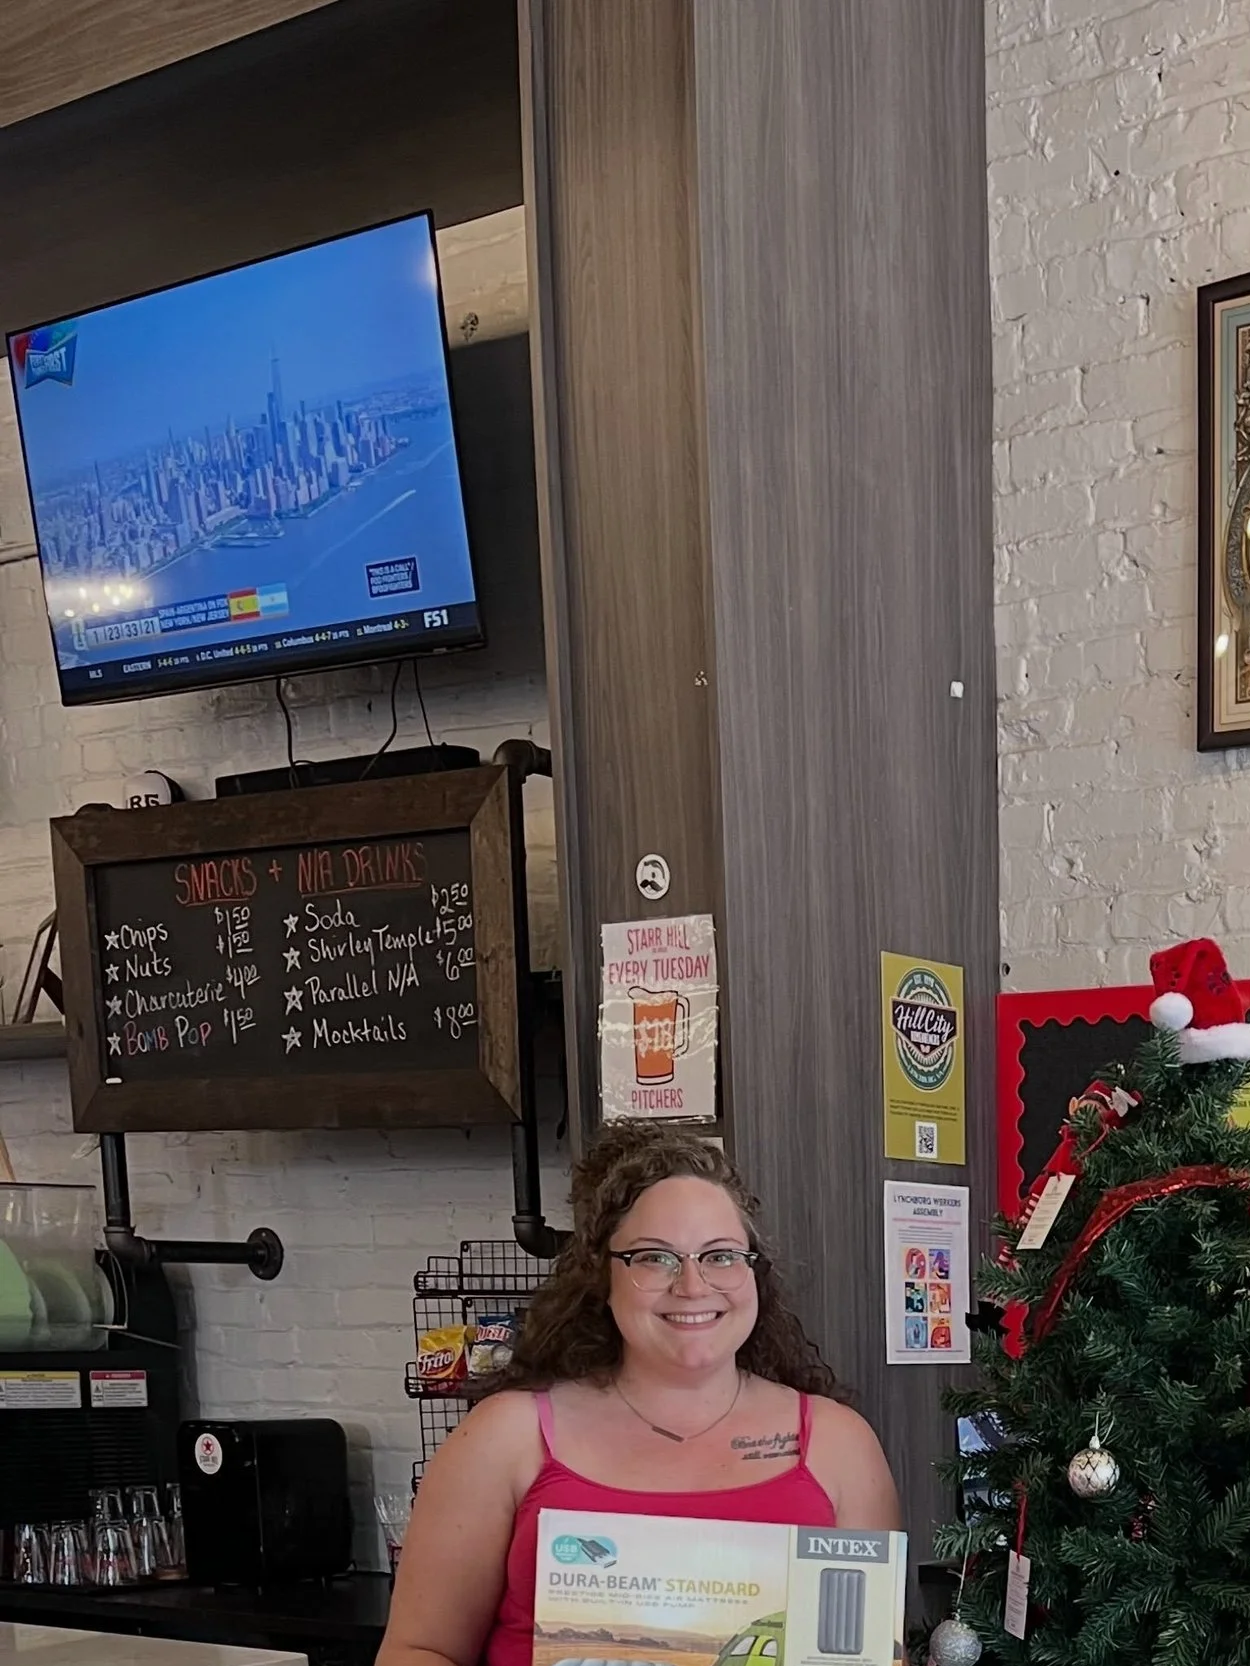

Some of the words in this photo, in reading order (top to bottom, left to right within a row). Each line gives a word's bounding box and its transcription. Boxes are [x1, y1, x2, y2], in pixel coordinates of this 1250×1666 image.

[108, 627, 121, 641] 23
[125, 623, 138, 637] 33
[145, 620, 155, 634] 21
[424, 609, 448, 628] FS1
[175, 857, 257, 904] SNACKS
[343, 842, 428, 887] DRINKS
[305, 899, 360, 932] Soda
[120, 922, 168, 951] Chips
[308, 932, 375, 967] Shirley
[371, 924, 434, 962] Temple
[627, 927, 663, 955] STARR
[667, 924, 691, 951] HILL
[126, 951, 172, 982] Nuts
[608, 959, 649, 985] EVERY
[653, 955, 710, 981] TUESDAY
[125, 979, 228, 1019] Charcuterie
[305, 969, 380, 1005] Parallel
[388, 962, 420, 997] N/A
[313, 1014, 407, 1048] Mocktails
[631, 1088, 684, 1110] PITCHERS
[807, 1536, 881, 1557] INTEX
[549, 1572, 658, 1591] DURA-BEAM
[664, 1579, 761, 1597] STANDARD
